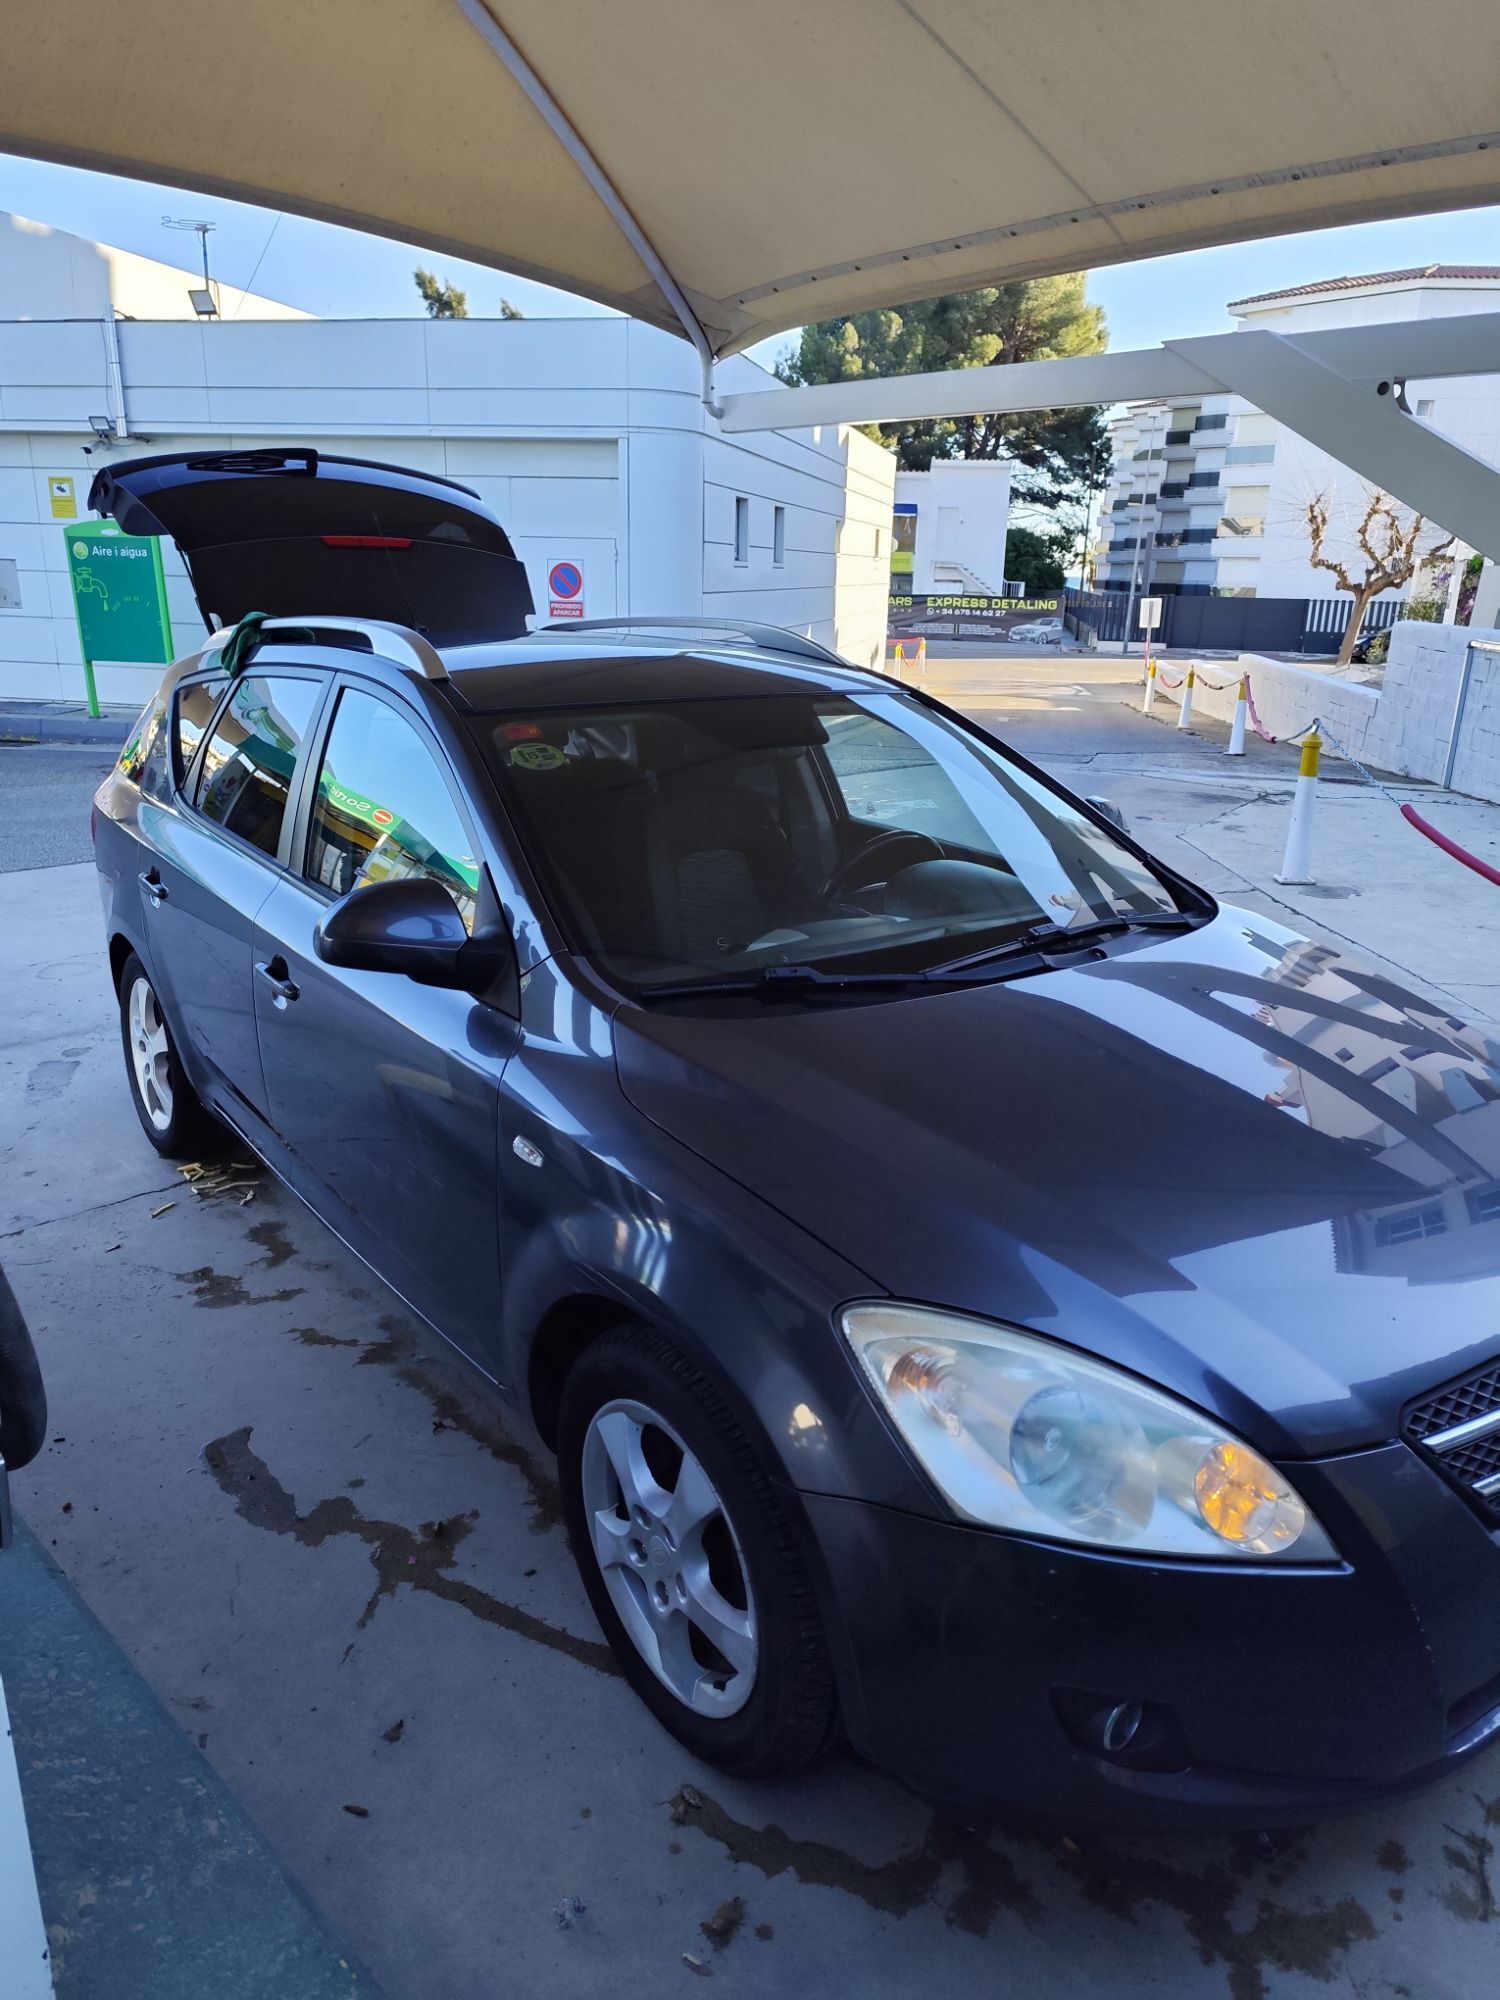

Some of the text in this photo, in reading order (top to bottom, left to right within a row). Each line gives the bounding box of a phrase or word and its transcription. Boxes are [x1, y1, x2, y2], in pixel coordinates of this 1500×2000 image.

[92, 545, 148, 559] Aire i aigua
[888, 596, 913, 606] ARS
[926, 597, 1058, 610] EXPRESS DETALING
